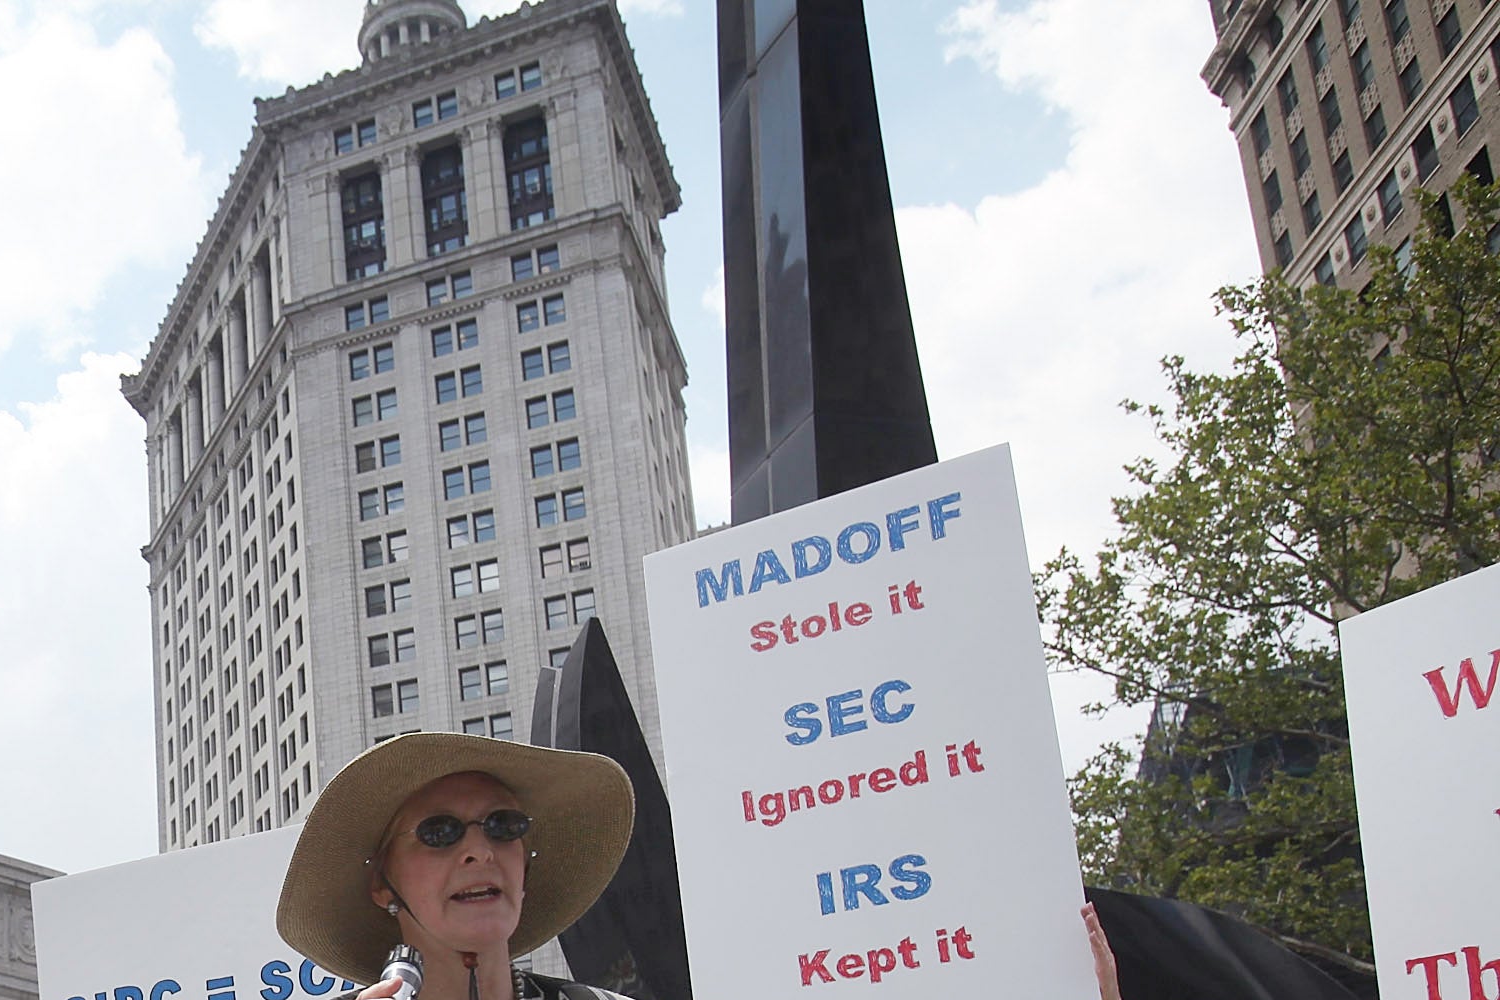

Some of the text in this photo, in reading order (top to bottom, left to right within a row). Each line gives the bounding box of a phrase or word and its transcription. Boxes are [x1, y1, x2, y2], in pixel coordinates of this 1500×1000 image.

[695, 492, 962, 608] MADOFF
[749, 580, 925, 652] Stole it
[784, 679, 916, 746] SEC
[741, 739, 985, 827] Ignored it
[817, 853, 932, 915] IRS
[798, 926, 975, 986] Kept it
